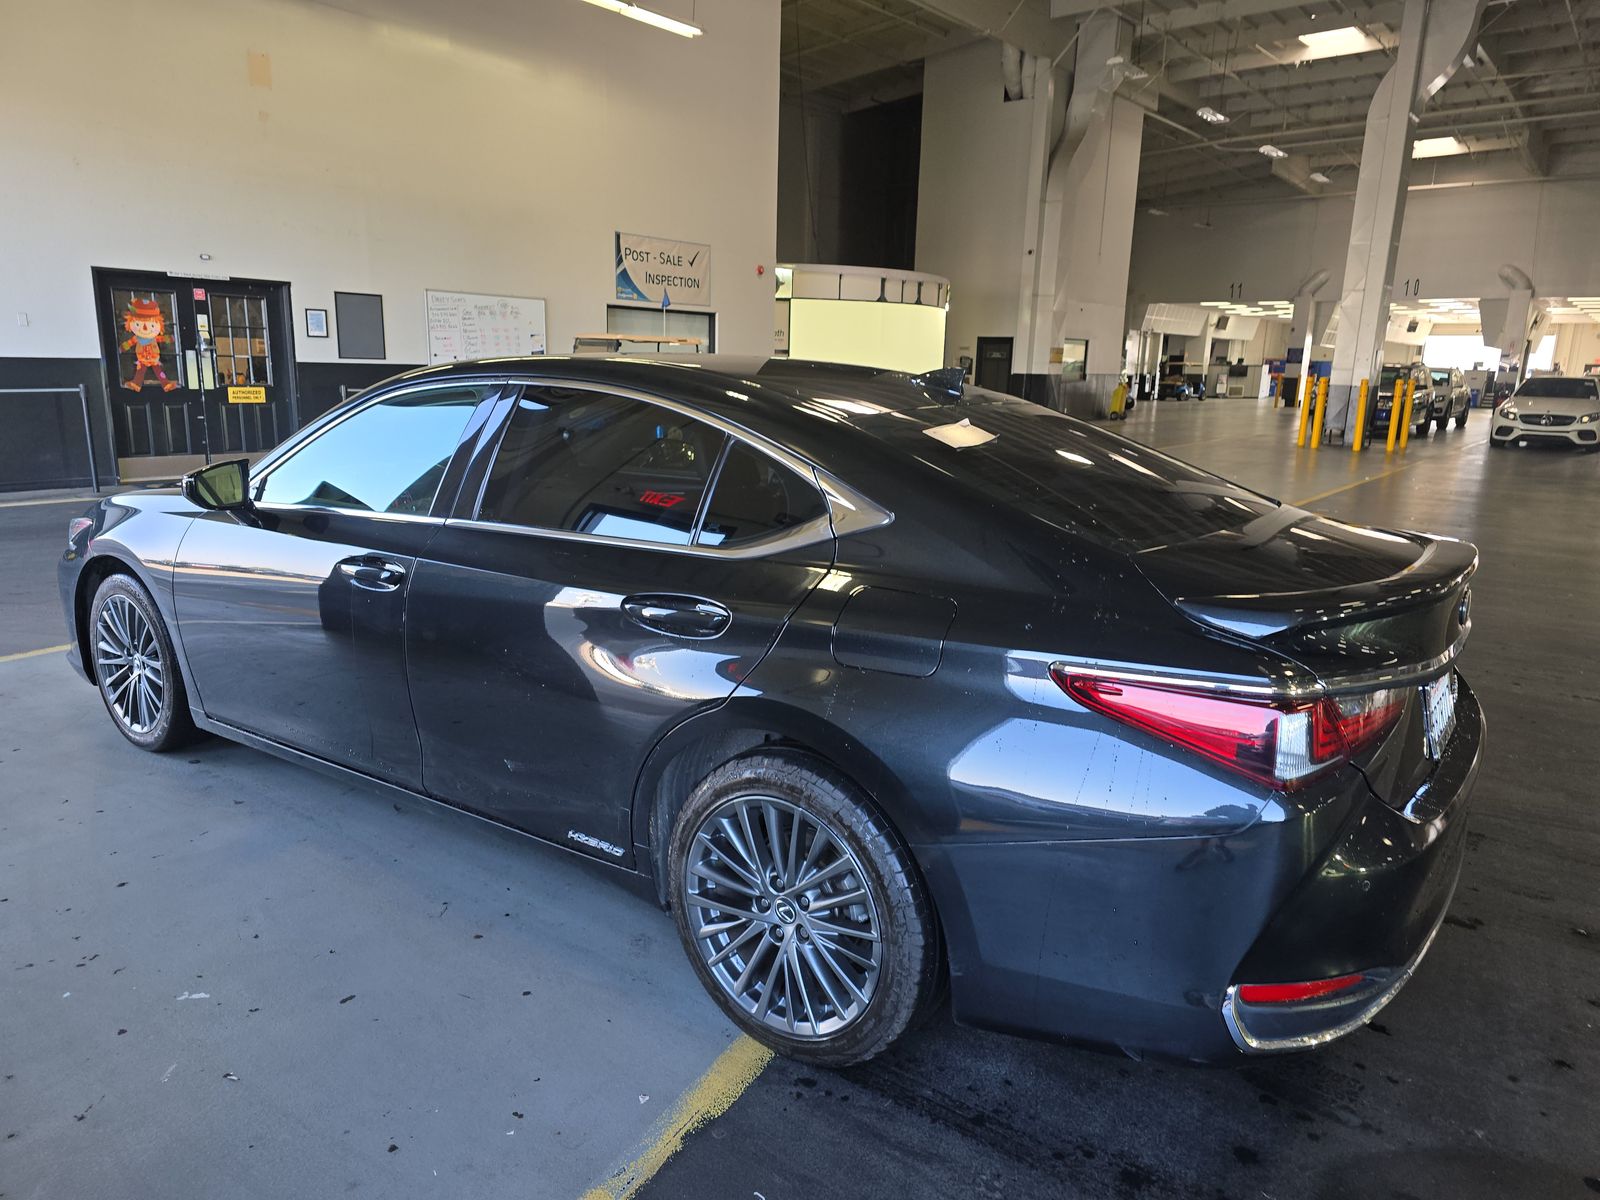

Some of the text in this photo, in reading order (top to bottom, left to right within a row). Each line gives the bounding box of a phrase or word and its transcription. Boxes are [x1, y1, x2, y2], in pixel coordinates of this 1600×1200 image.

[624, 247, 651, 263] POST
[659, 251, 683, 267] SALE
[645, 271, 700, 289] INSPECTION
[1404, 279, 1420, 296] 10
[1230, 282, 1243, 299] 11
